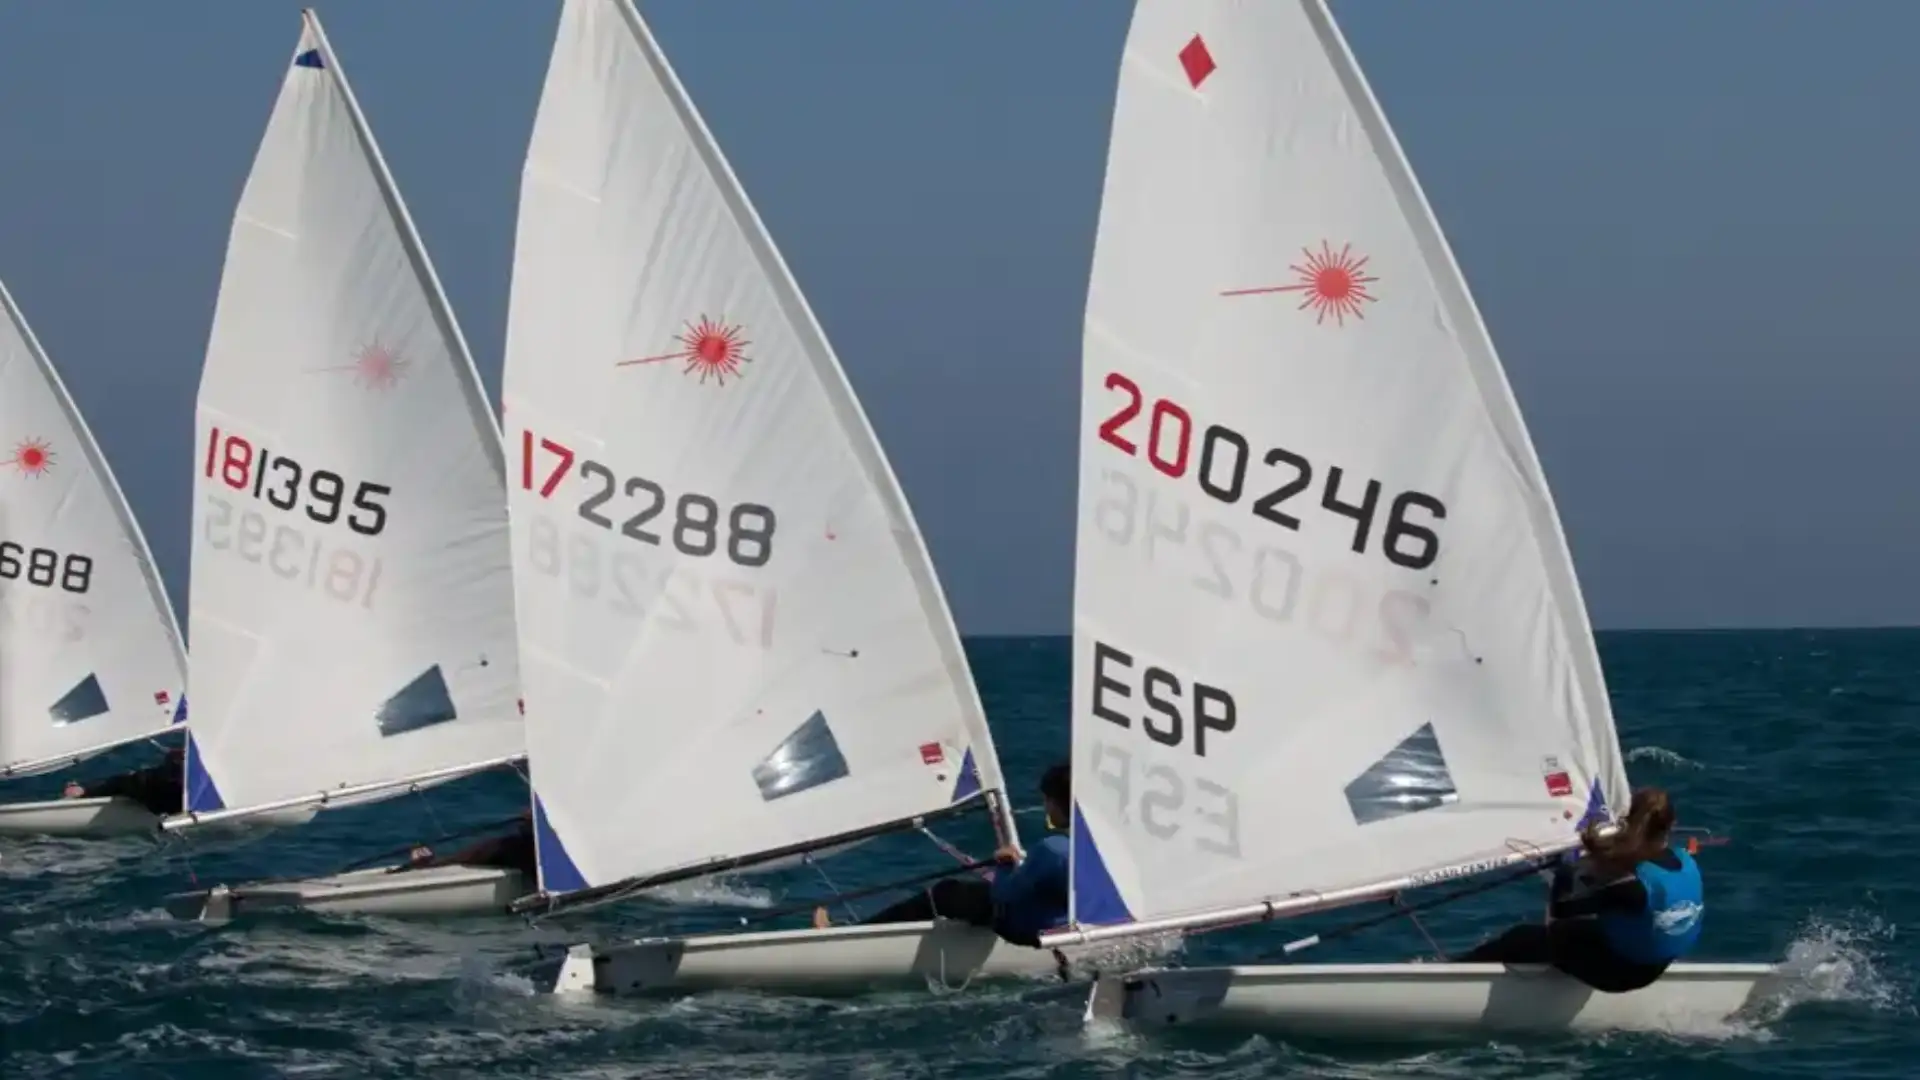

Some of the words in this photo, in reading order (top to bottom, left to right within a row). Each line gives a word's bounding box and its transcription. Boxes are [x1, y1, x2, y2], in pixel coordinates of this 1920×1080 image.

[206, 427, 391, 536] 181395
[522, 430, 776, 567] 172288
[1099, 372, 1447, 570] 200246
[0, 541, 92, 594] 688
[1092, 642, 1237, 757] ESP
